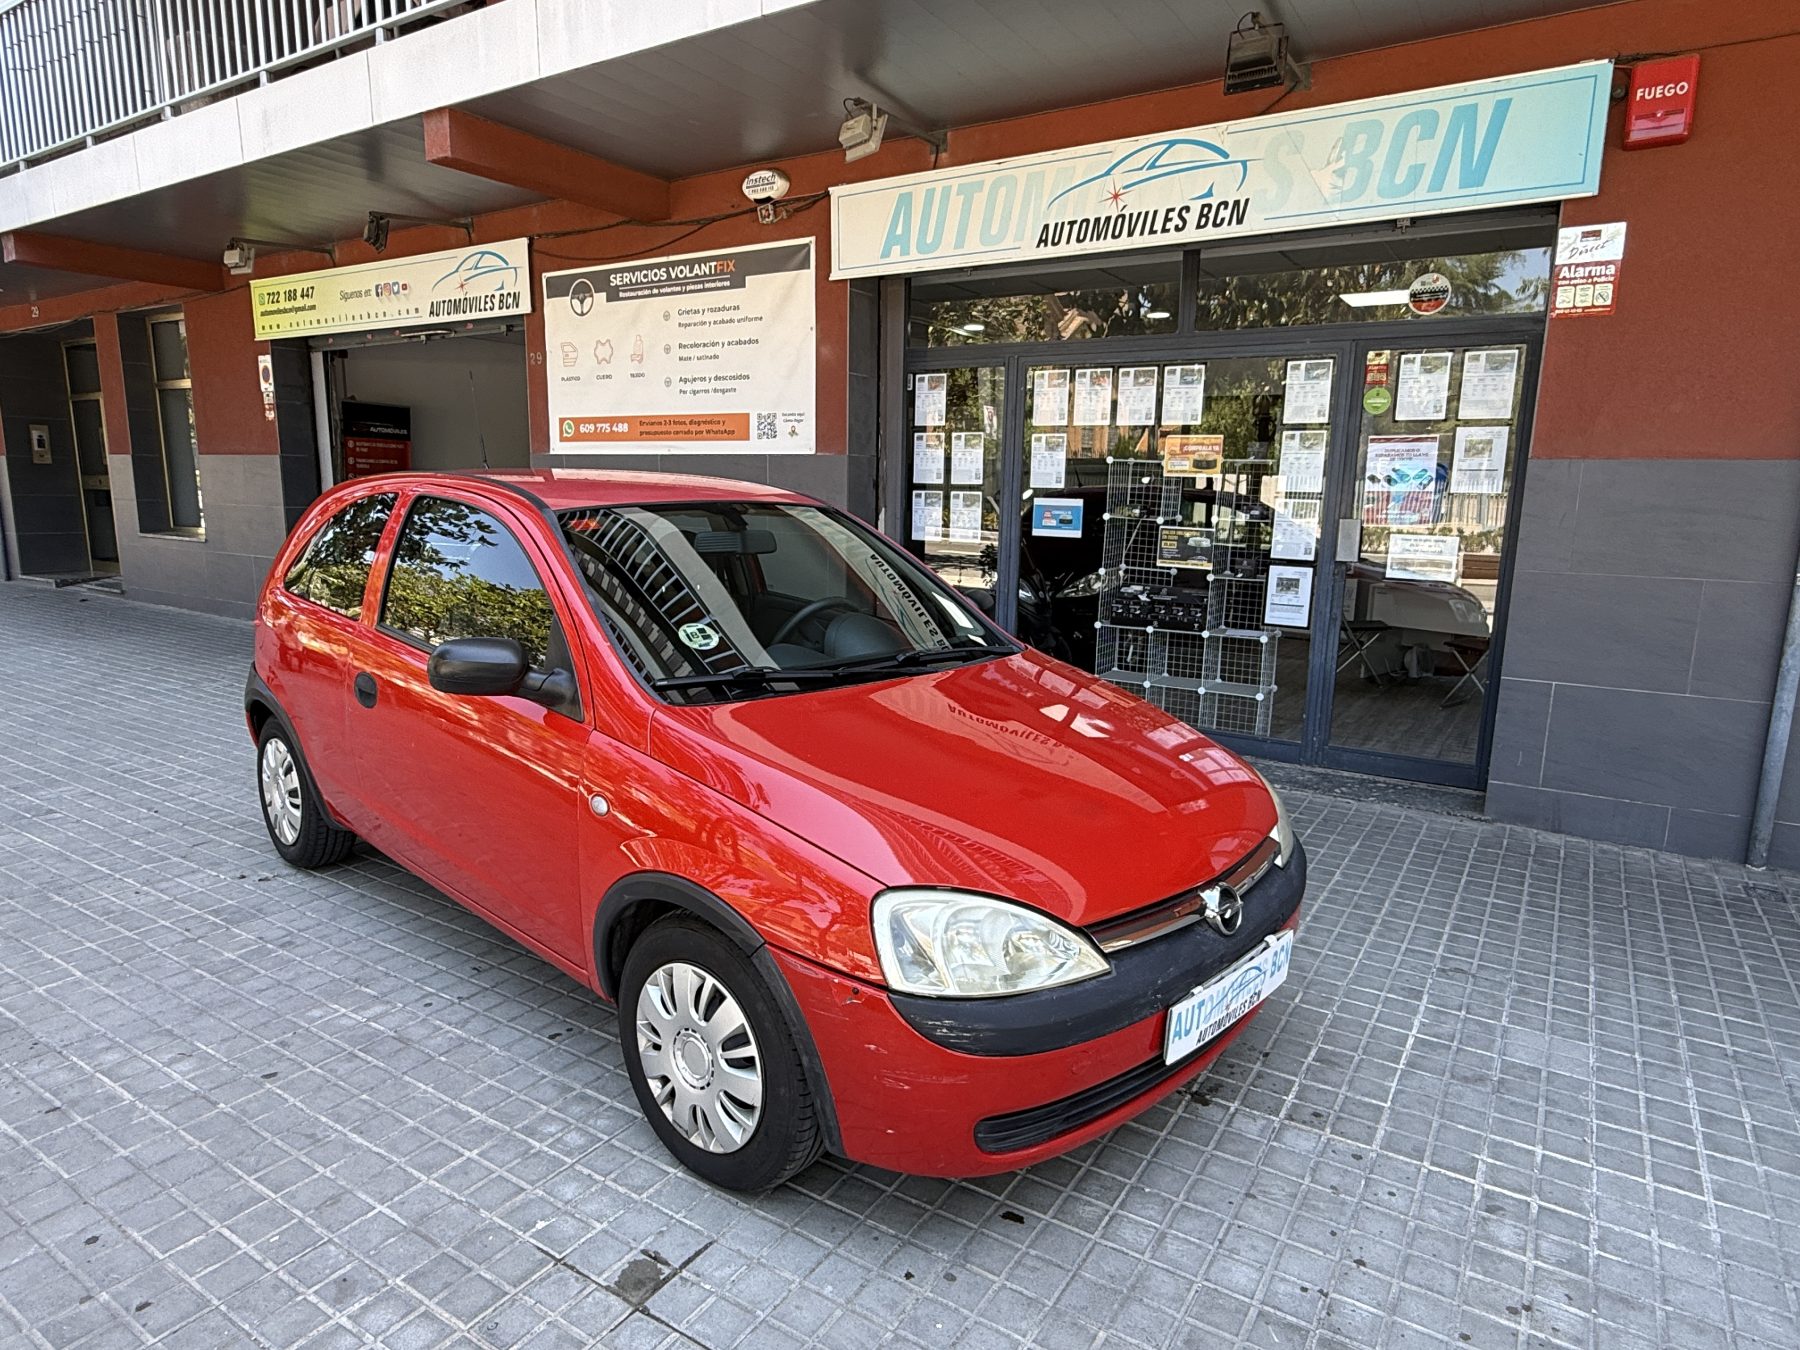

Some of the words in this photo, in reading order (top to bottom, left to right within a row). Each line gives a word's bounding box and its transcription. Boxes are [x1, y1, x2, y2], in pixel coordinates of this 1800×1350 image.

[1636, 81, 1688, 101] FUEGO
[1341, 97, 1513, 200] BCN
[1036, 204, 1190, 248] AUTOMÓVILES
[1195, 197, 1250, 230] BCN
[609, 267, 667, 286] SERVICIOS
[669, 259, 736, 279] VOLANTFIX
[1558, 264, 1616, 279] Alarma
[704, 280, 731, 289] interiores
[266, 291, 280, 304] 722
[283, 288, 298, 302] 188
[300, 285, 315, 300] 447
[428, 291, 495, 317] AUTOMÓVILES
[498, 291, 521, 309] BCN
[677, 308, 700, 316] Grietas
[707, 304, 740, 313] rozaduras
[31, 305, 39, 317] 29
[678, 320, 707, 329] Reparación
[712, 317, 736, 325] acabado
[736, 315, 763, 323] uniforme
[678, 341, 720, 350] Recoloración
[727, 338, 760, 346] acabados
[530, 352, 542, 365] 29
[678, 376, 707, 385] Agujeros
[713, 373, 750, 381] descosidos
[579, 423, 595, 433] 609
[595, 423, 611, 432] 775
[611, 422, 629, 432] 488
[705, 428, 736, 437] WhatsApp
